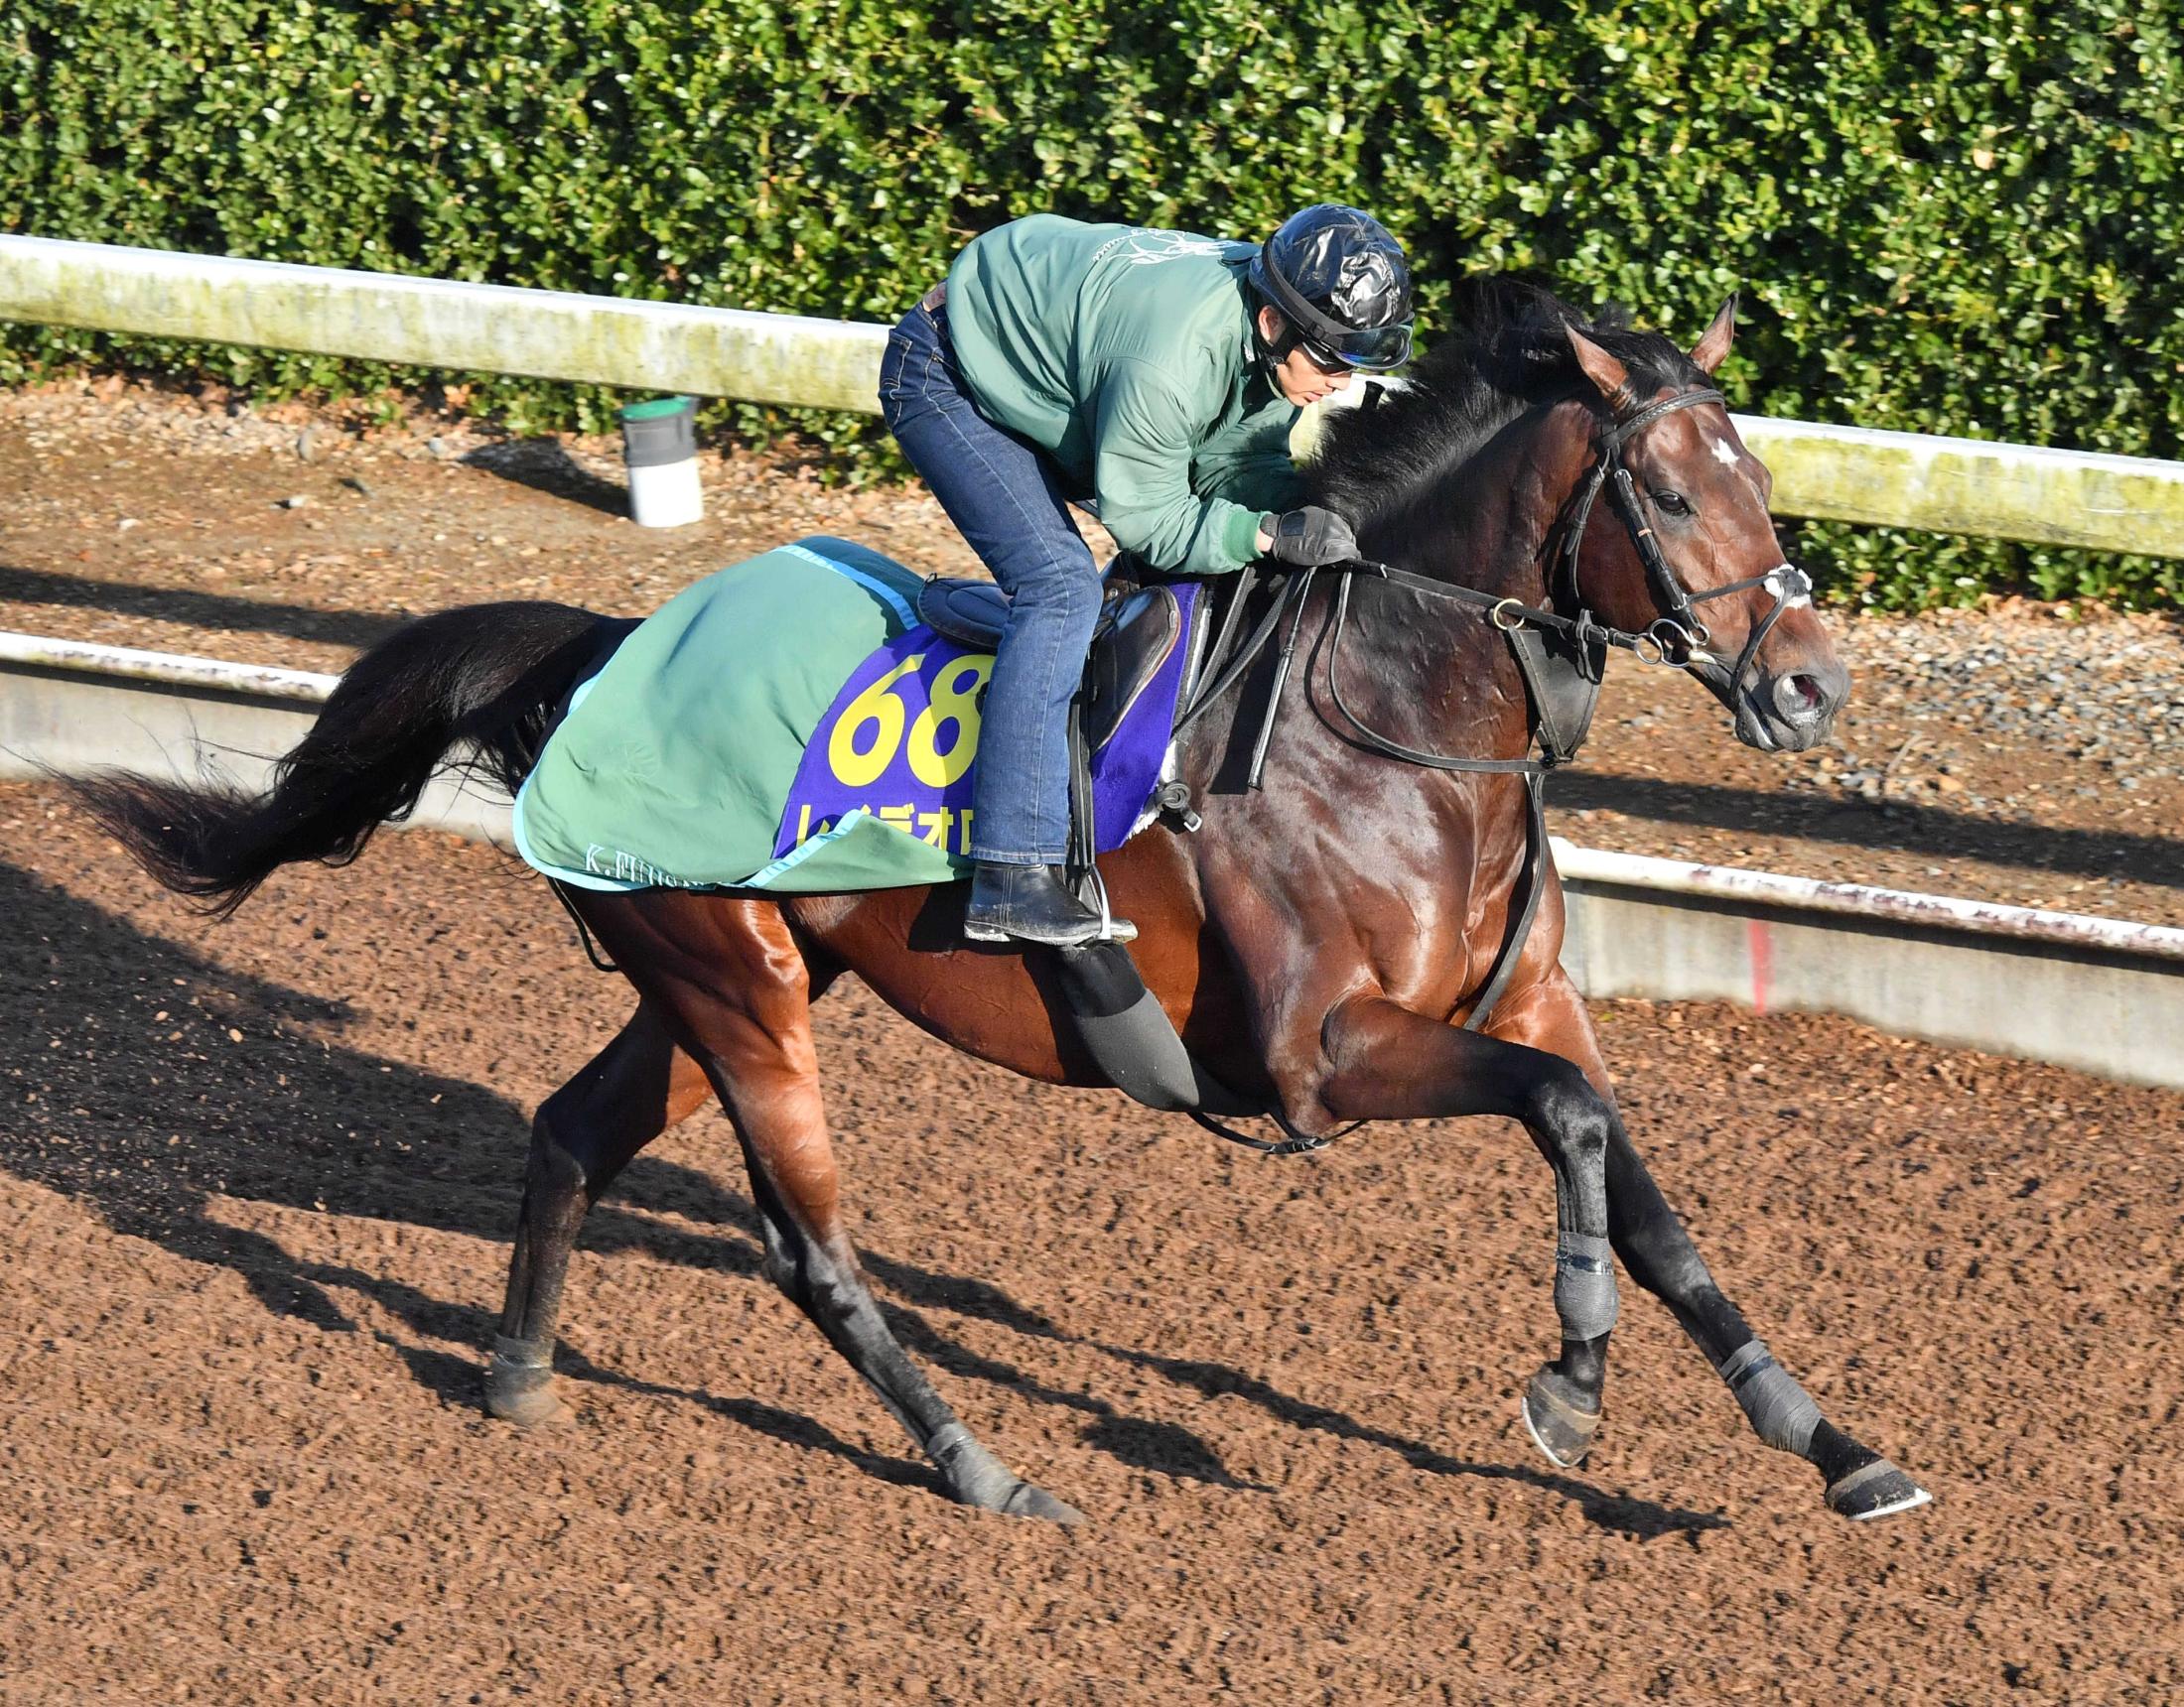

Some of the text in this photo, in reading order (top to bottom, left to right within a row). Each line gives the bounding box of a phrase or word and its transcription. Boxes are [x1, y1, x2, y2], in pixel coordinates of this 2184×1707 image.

[828, 653, 997, 787] 68
[796, 802, 975, 855] レデオ
